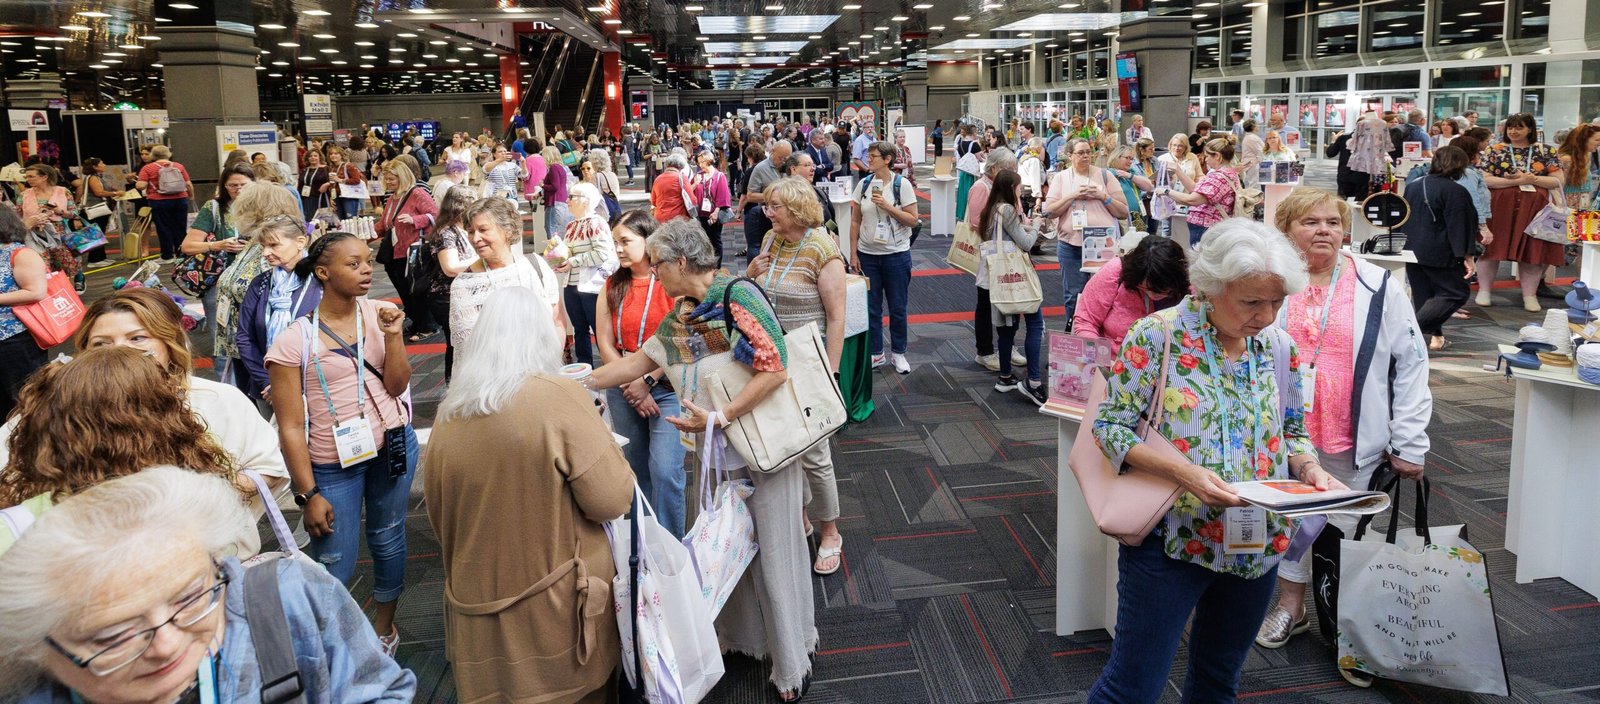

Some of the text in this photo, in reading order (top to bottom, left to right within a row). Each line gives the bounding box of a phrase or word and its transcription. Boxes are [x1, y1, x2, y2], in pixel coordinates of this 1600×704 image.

[1368, 563, 1450, 578] I'M GOING MAKE
[1382, 579, 1441, 600] EVERYING
[1396, 596, 1431, 611] AROD
[1388, 614, 1445, 632] BEAUIFUL
[1374, 623, 1457, 648] AND THAT WILL BE
[1403, 652, 1417, 662] my
